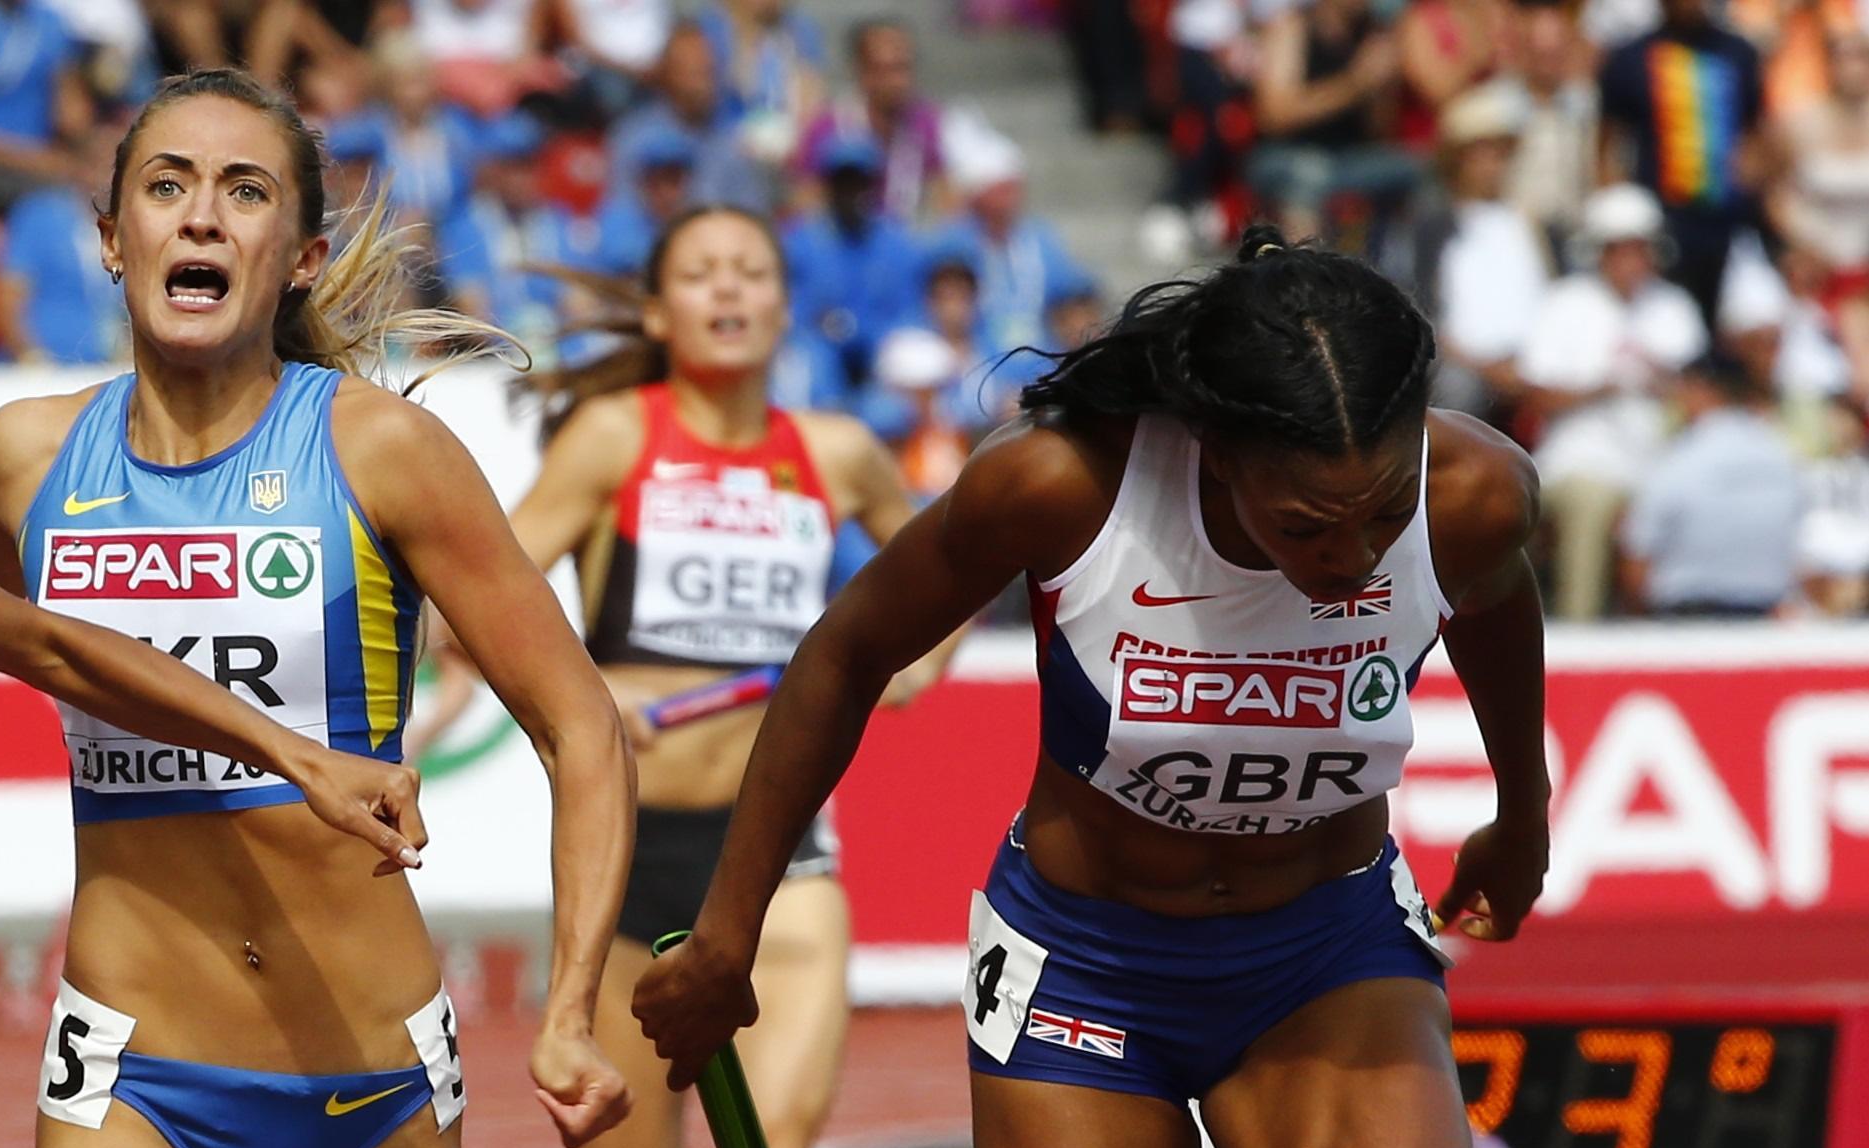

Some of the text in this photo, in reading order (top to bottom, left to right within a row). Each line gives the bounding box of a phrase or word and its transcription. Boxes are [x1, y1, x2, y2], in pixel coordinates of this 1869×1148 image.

[51, 543, 233, 591] SPAR
[667, 555, 805, 612] GER
[1127, 667, 1338, 720] SPAR
[1138, 750, 1369, 804] GBR
[974, 943, 1008, 1027] 4
[47, 1013, 91, 1101] 5
